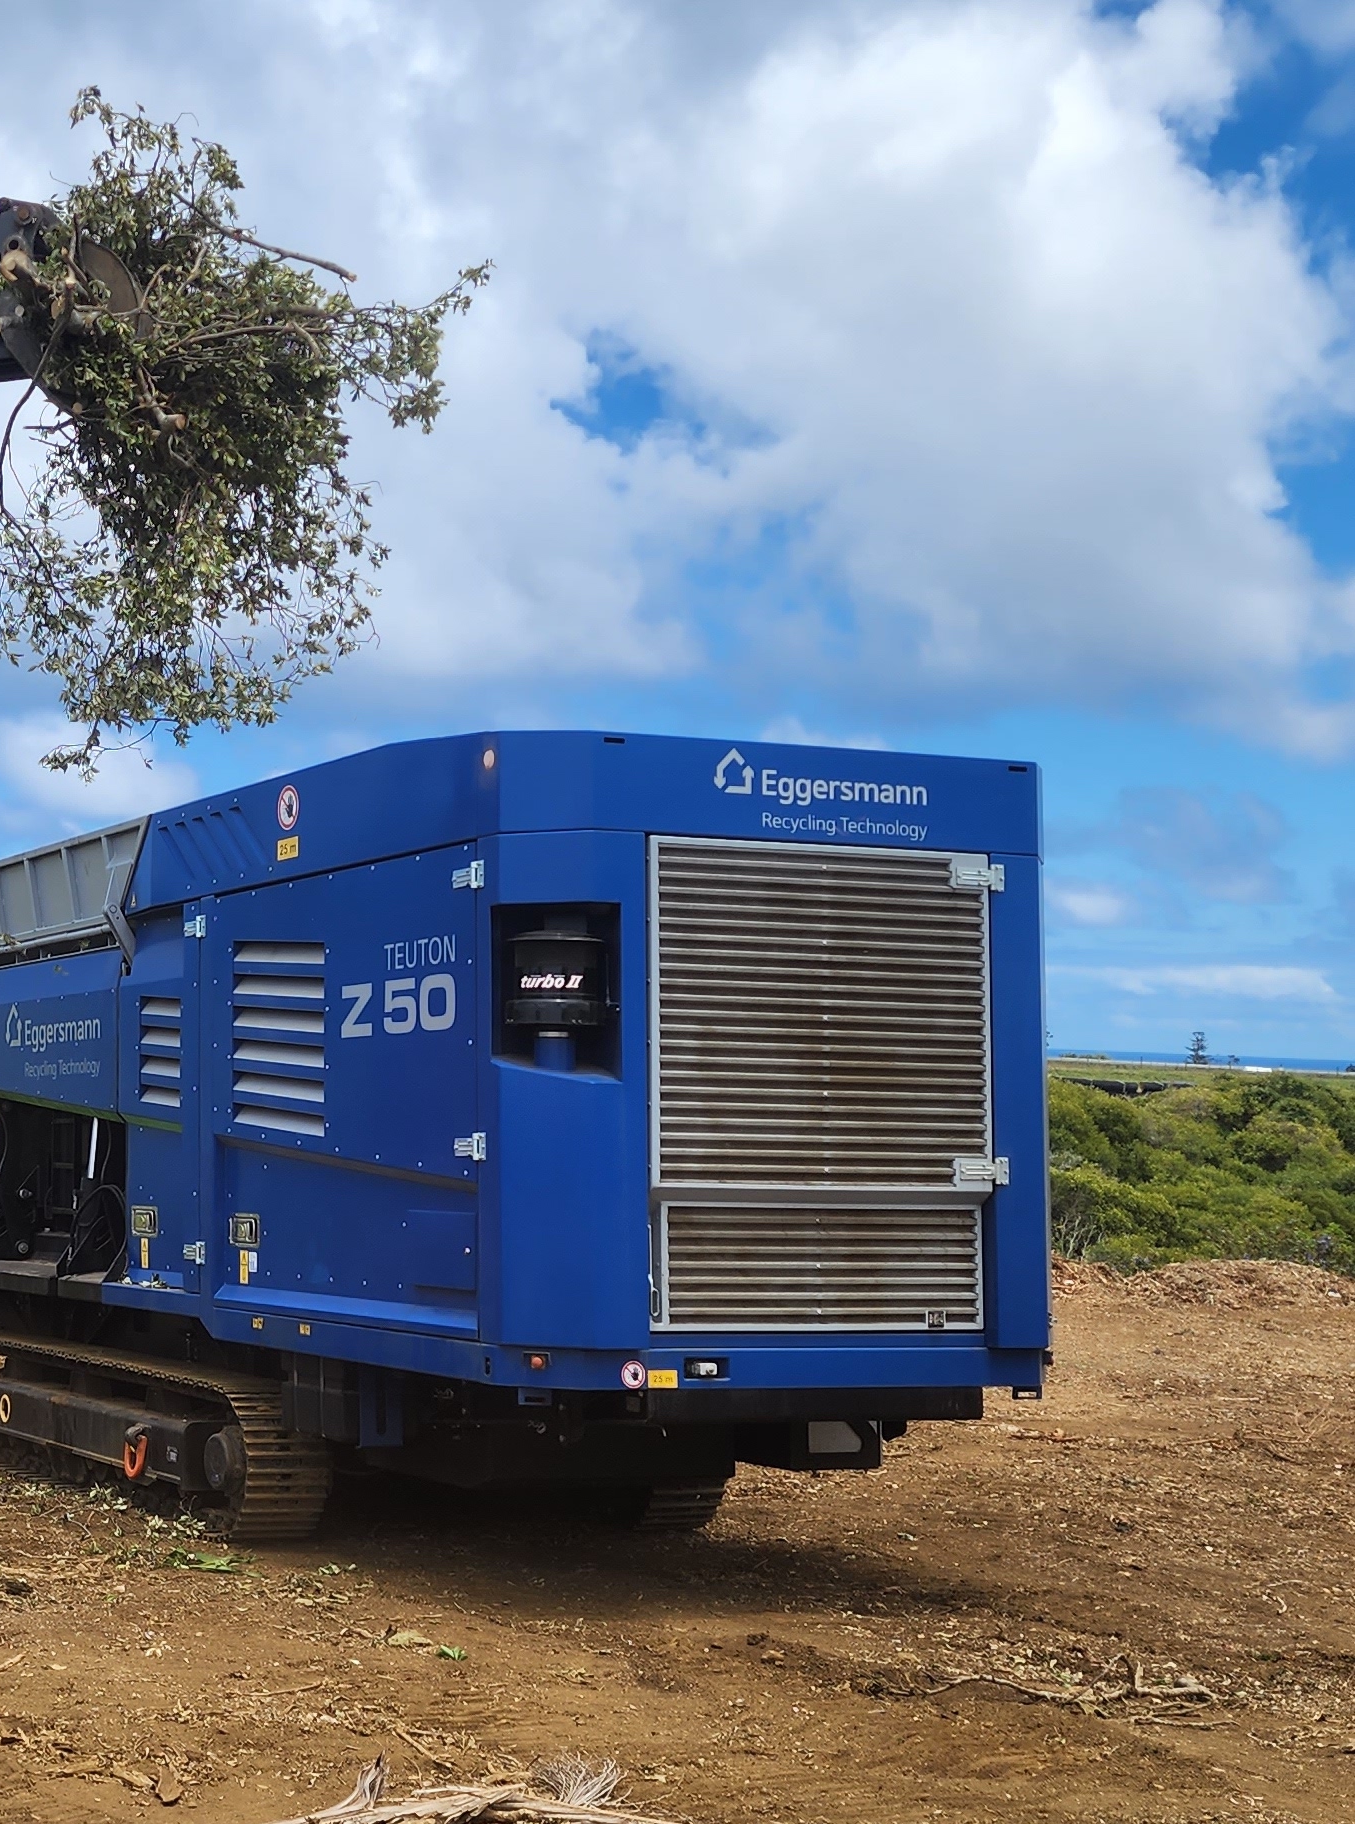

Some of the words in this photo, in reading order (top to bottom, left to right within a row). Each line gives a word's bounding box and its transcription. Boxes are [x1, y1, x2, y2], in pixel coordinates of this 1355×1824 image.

[761, 769, 928, 806] Eggersmann
[762, 812, 836, 836] Recycling
[840, 817, 928, 841] Technology
[279, 843, 288, 856] 25
[289, 844, 297, 854] m
[384, 934, 456, 970] TEUTON
[520, 973, 566, 989] turbo
[341, 982, 373, 1038] Z
[383, 973, 456, 1034] 50
[25, 1018, 101, 1052] Eggersmann
[25, 1061, 57, 1080] Recycling
[58, 1058, 101, 1078] Technology
[653, 1374, 663, 1383] 25
